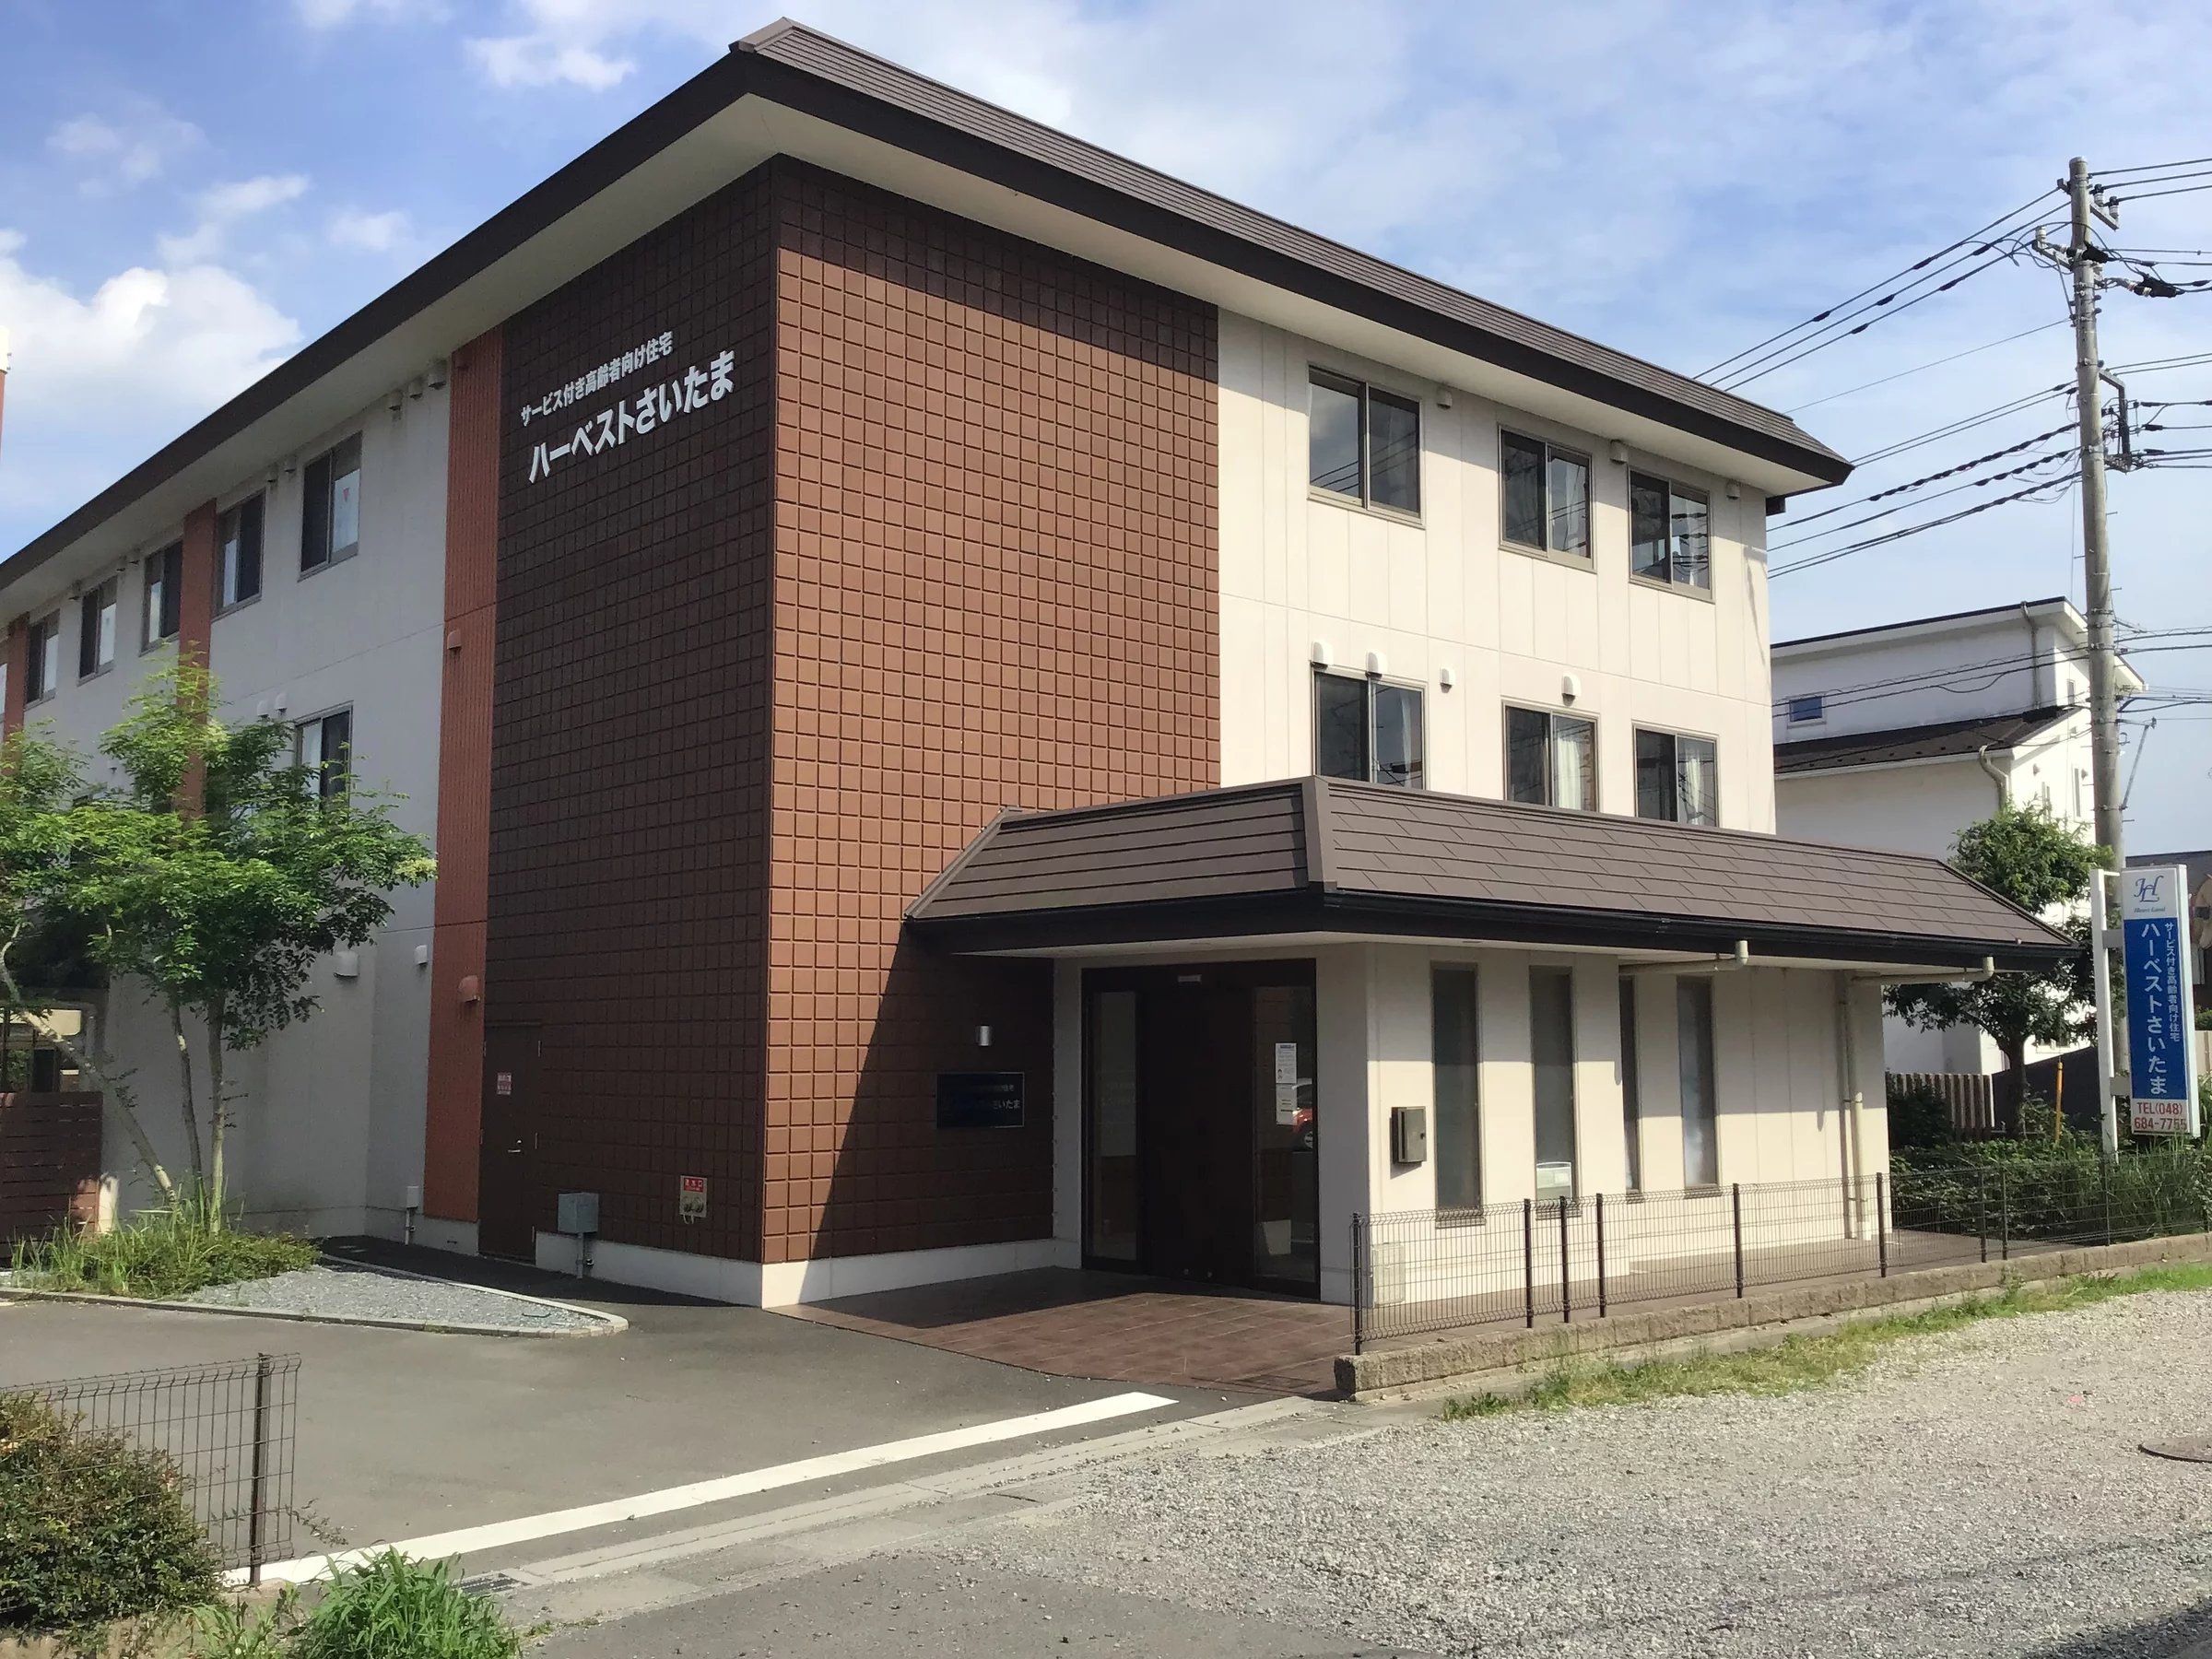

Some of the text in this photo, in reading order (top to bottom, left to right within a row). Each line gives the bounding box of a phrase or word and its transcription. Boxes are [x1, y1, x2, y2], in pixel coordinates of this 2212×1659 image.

[521, 330, 674, 427] サービス付き高齢者向け住宅
[528, 349, 735, 484] ハーベストさいたま
[2140, 923, 2168, 1096] ハーベストさいたま
[2136, 1101, 2183, 1115] TEL(048)
